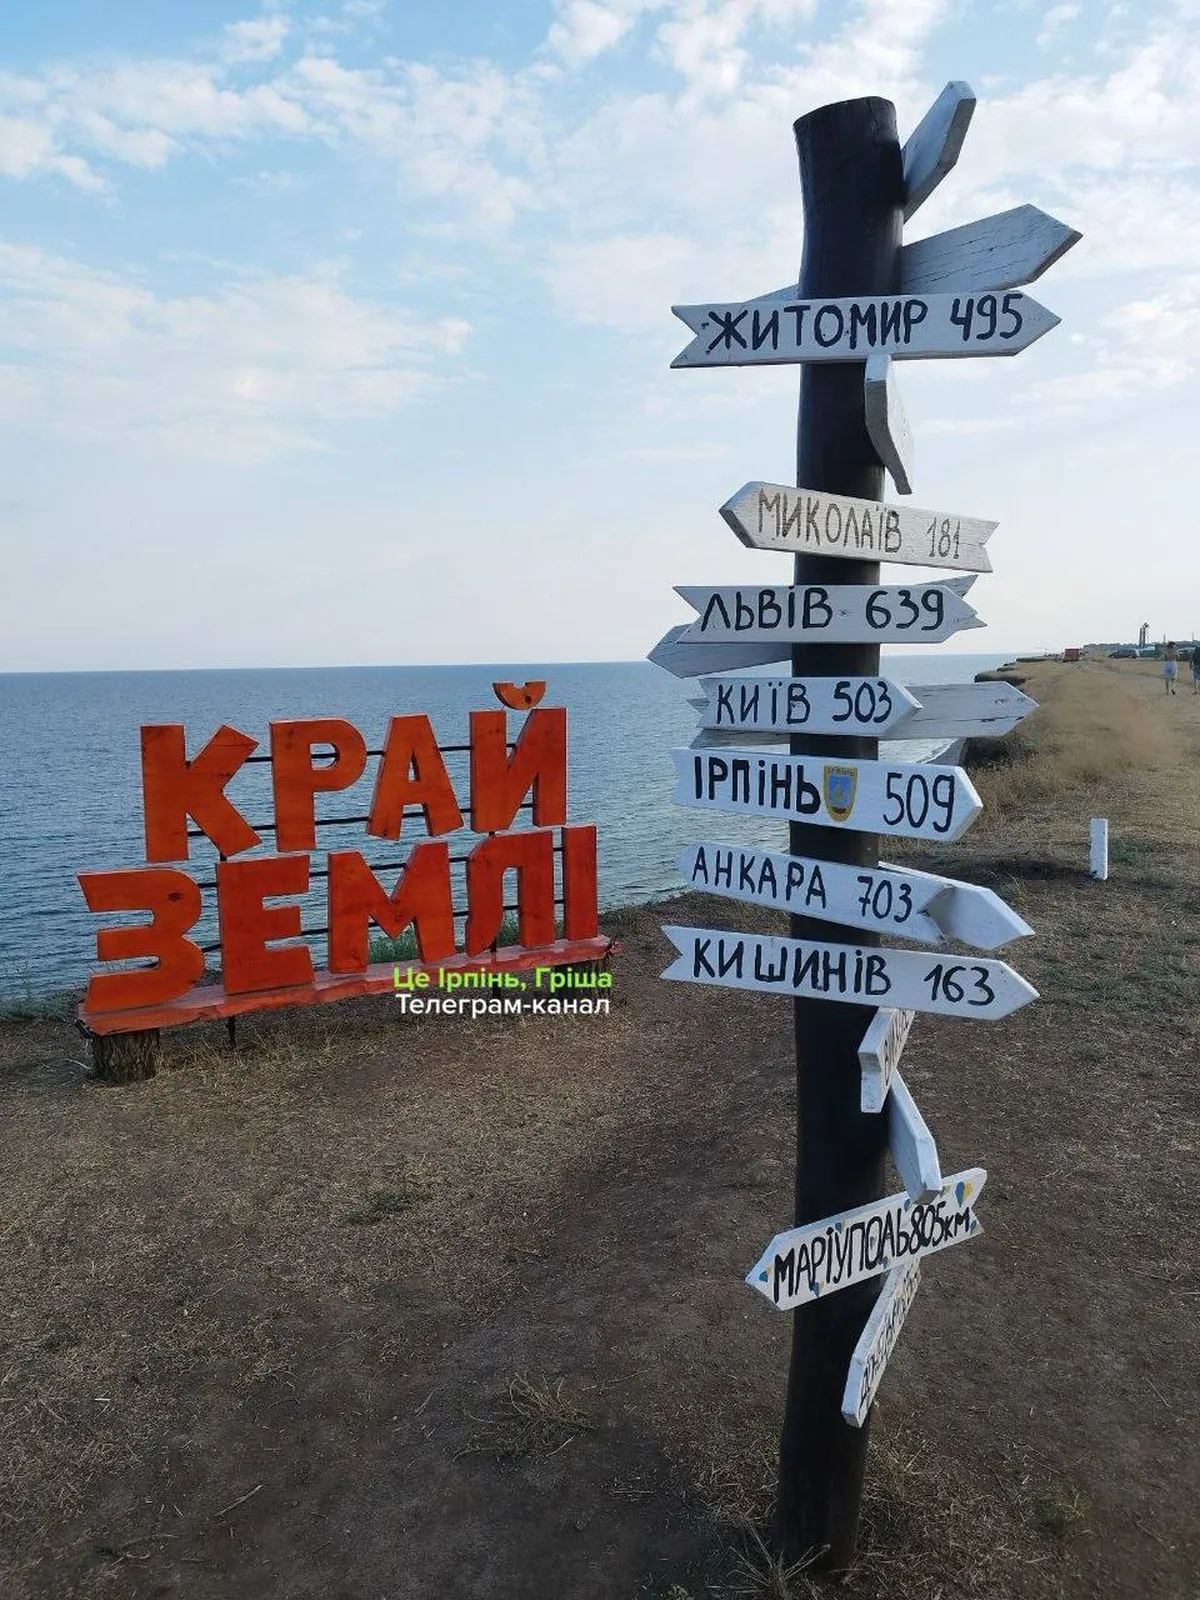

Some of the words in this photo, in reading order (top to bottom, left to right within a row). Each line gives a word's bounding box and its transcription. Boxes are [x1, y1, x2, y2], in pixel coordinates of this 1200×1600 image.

[708, 300, 928, 351] ЖИТОМИР
[951, 294, 1023, 342] 495
[758, 488, 903, 554] МИКОЛАЇВ
[927, 516, 961, 560] 181
[865, 589, 945, 631] 639
[716, 682, 811, 726] КИЇВ
[832, 681, 893, 724] 503
[140, 680, 568, 863] КРАЙ
[882, 773, 956, 832] 509
[692, 847, 827, 910] АНКАРА
[857, 876, 913, 923] 703
[75, 823, 599, 1014] ЗЕМЛІ
[923, 963, 996, 1006] 163
